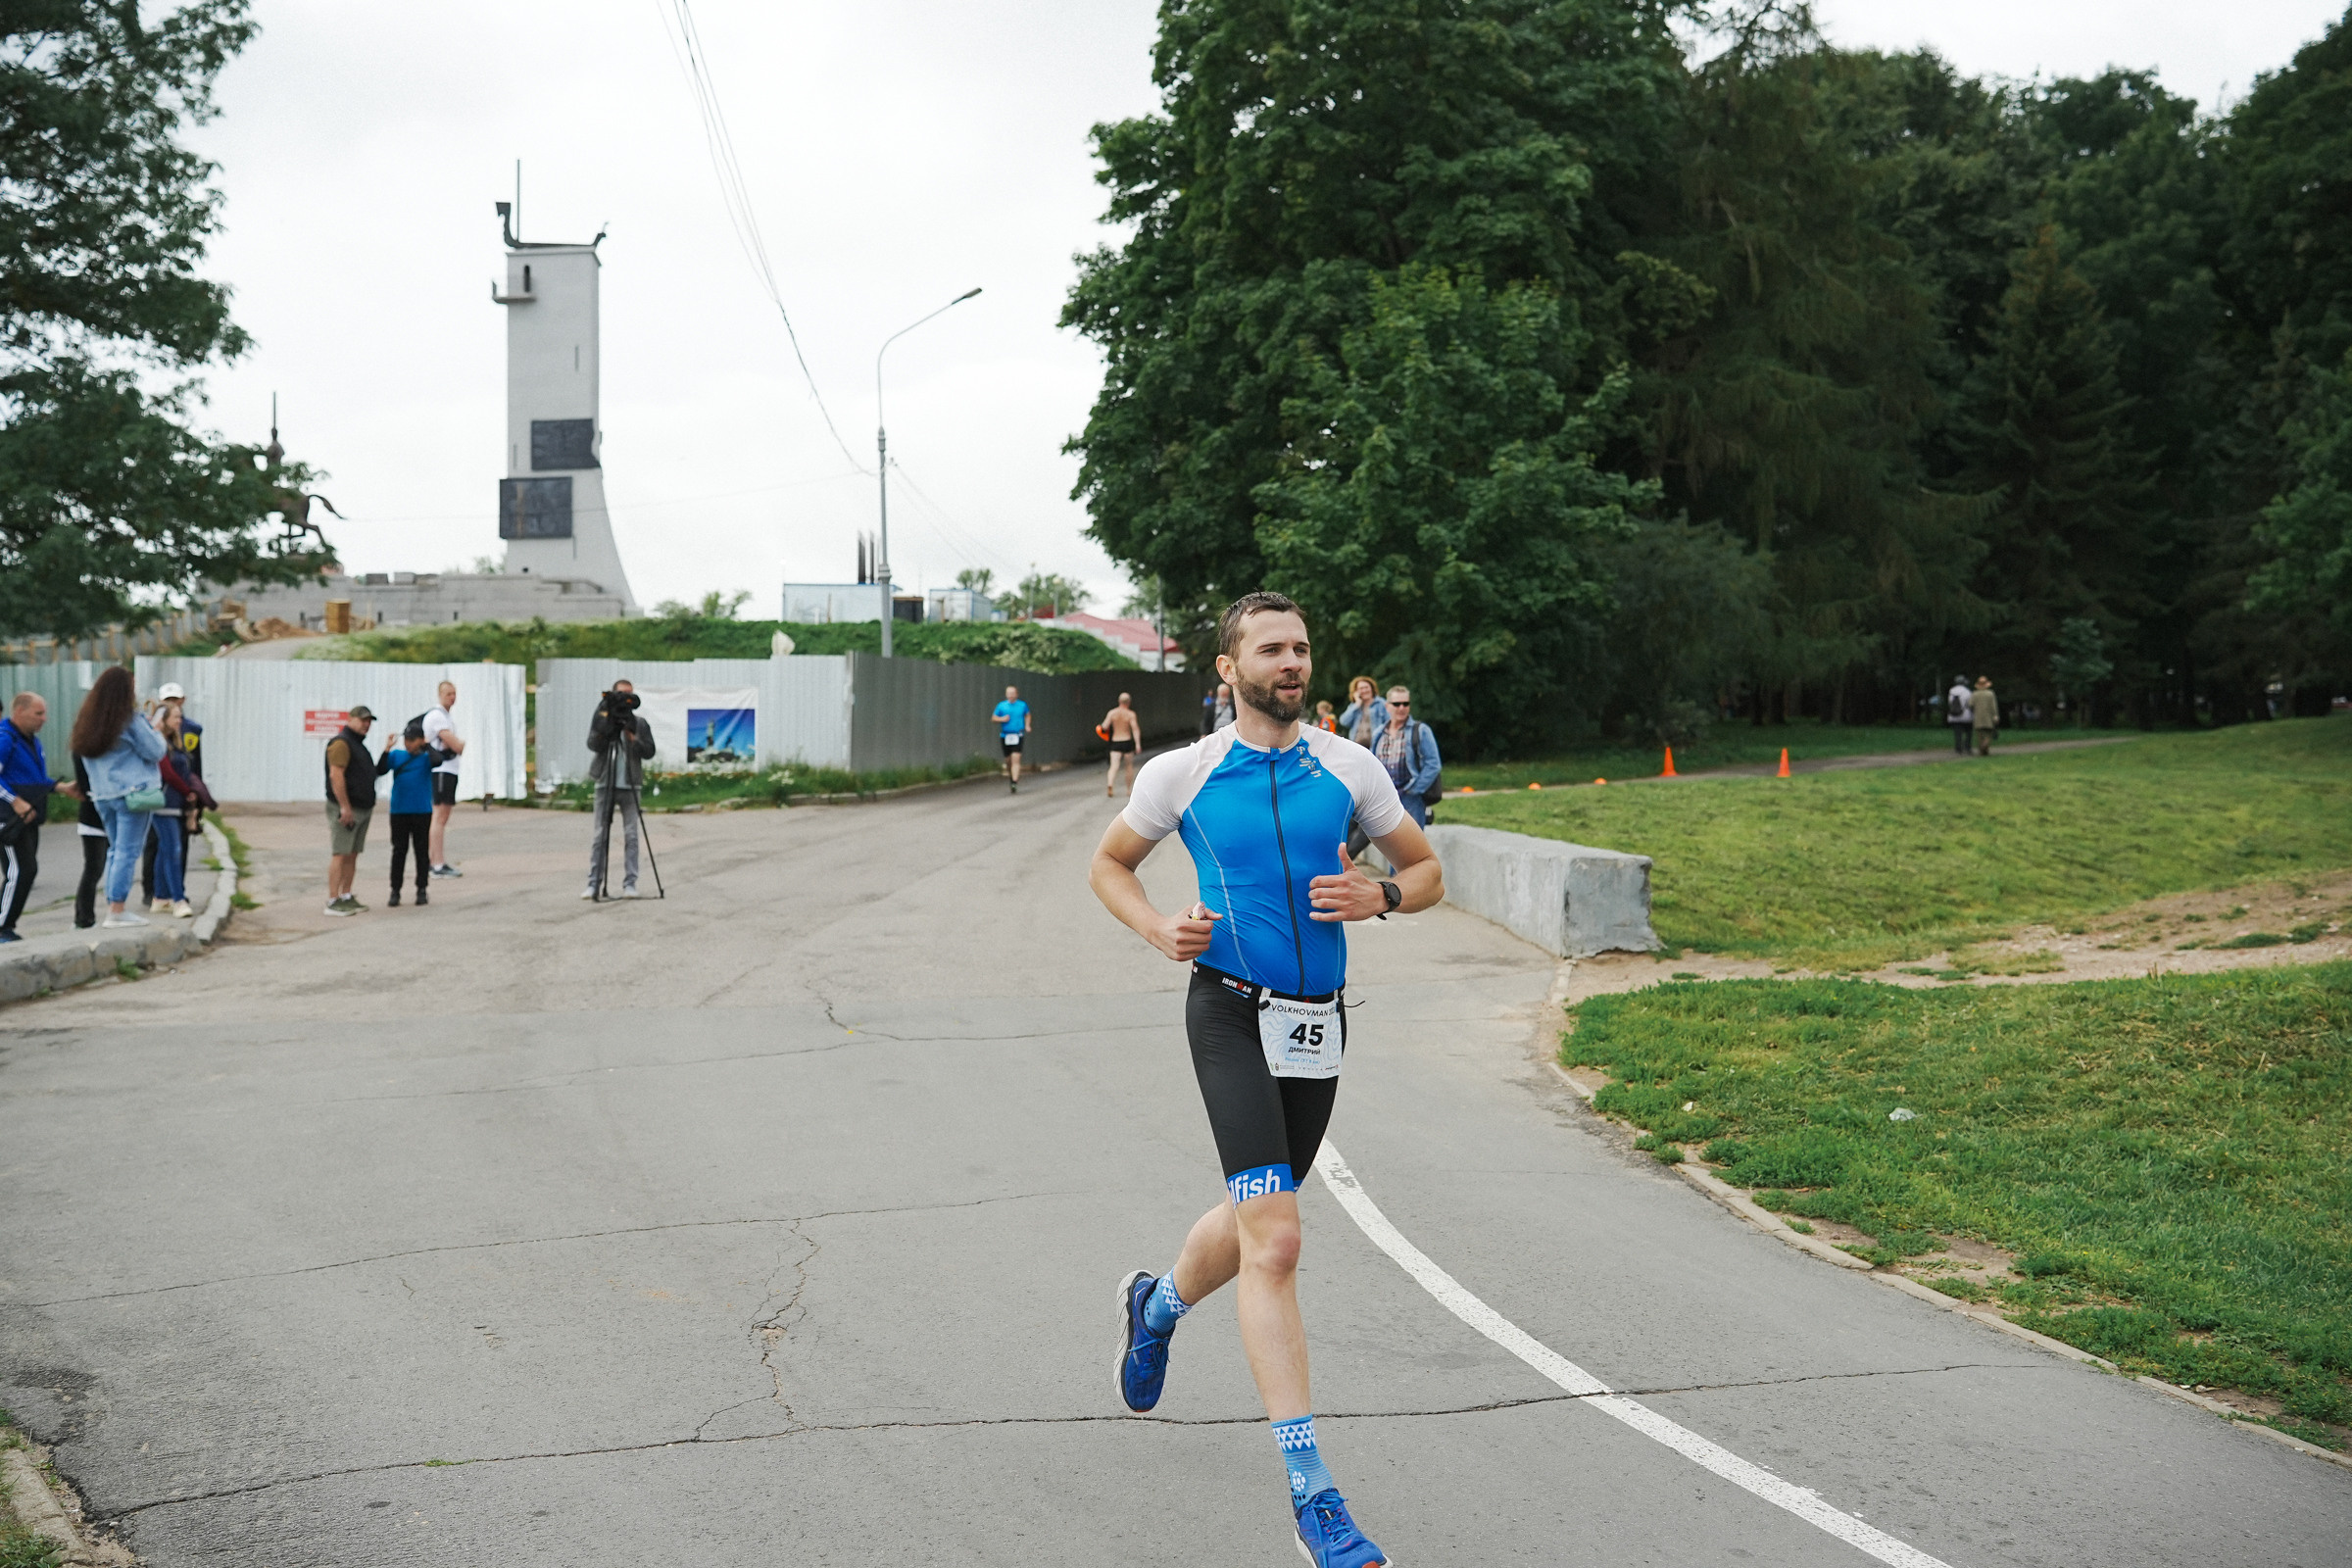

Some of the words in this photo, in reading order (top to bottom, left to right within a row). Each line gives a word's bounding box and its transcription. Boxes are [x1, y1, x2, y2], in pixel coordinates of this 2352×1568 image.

[1271, 1004, 1328, 1016] VOLKHOVMAN
[1289, 1023, 1325, 1047] 45
[1288, 1047, 1321, 1055] ДМИТРИЙ
